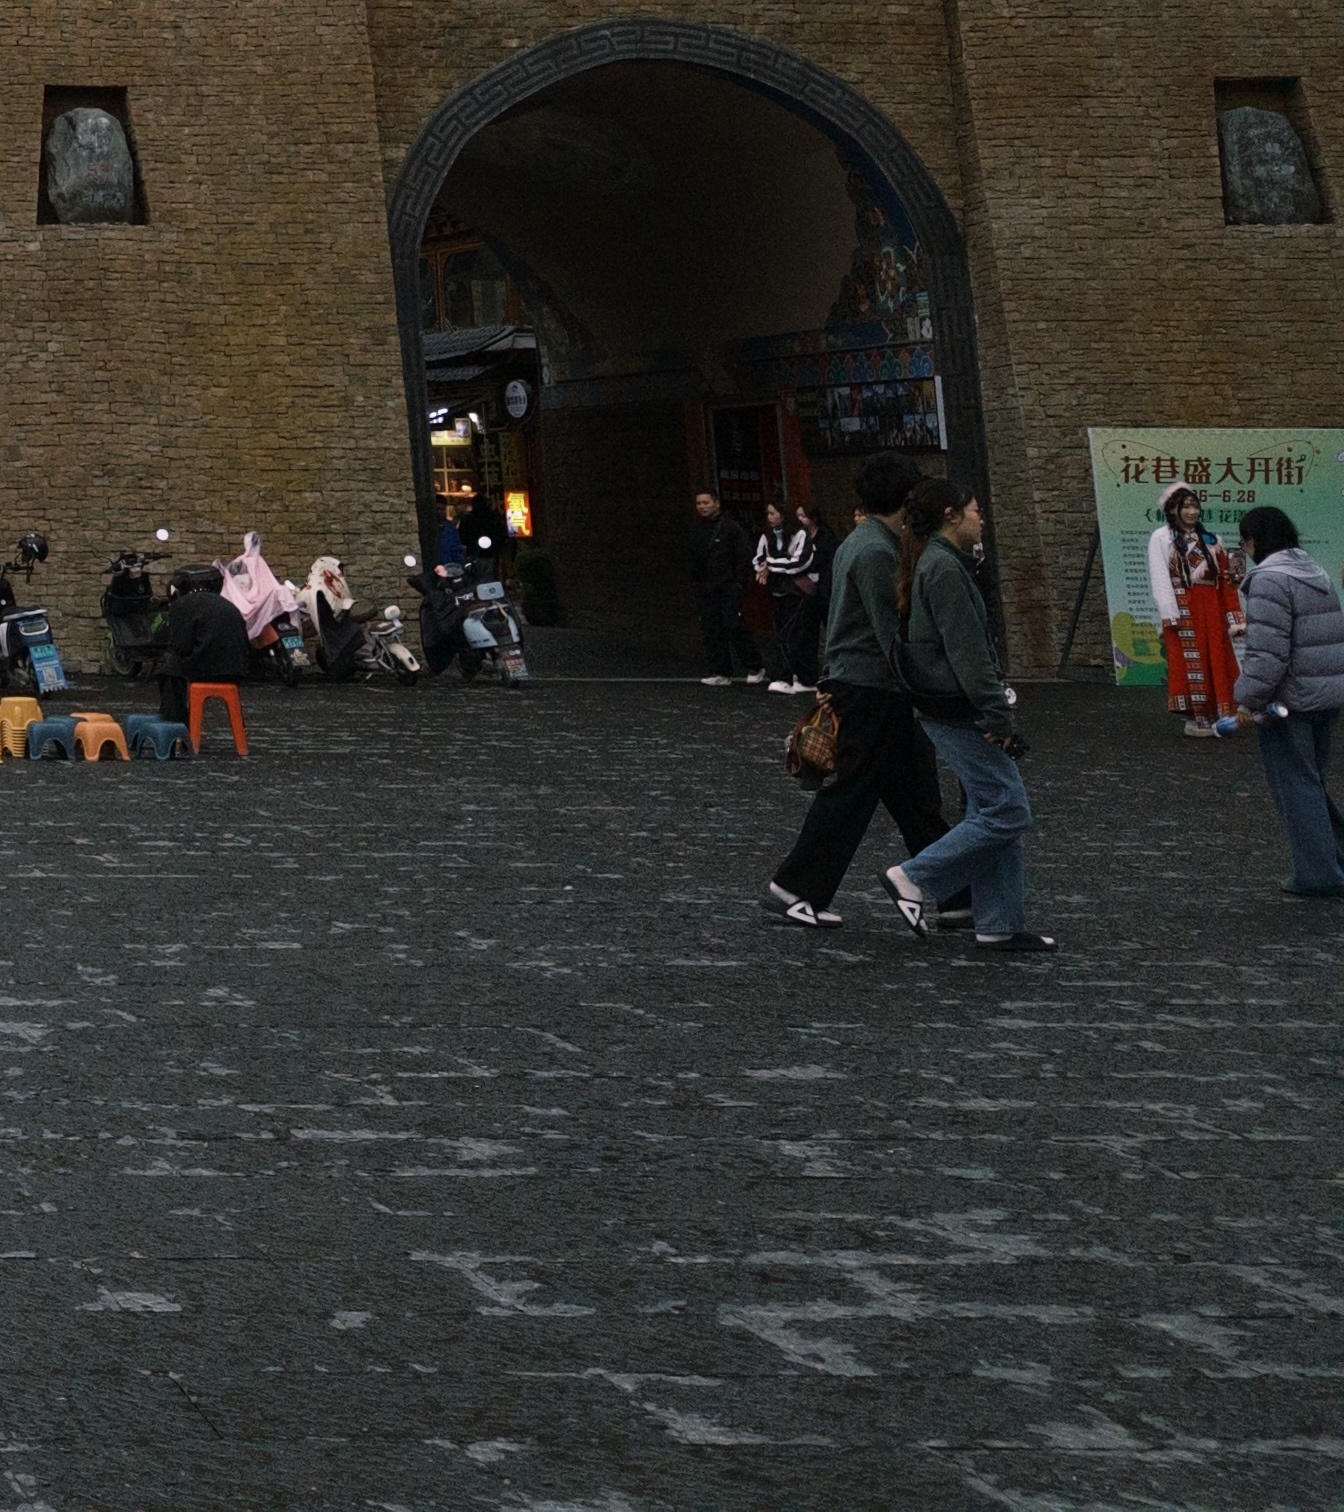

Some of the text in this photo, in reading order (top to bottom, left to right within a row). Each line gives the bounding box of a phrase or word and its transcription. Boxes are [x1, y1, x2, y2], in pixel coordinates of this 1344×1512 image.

[1120, 455, 1306, 486] 花巷盛大开街
